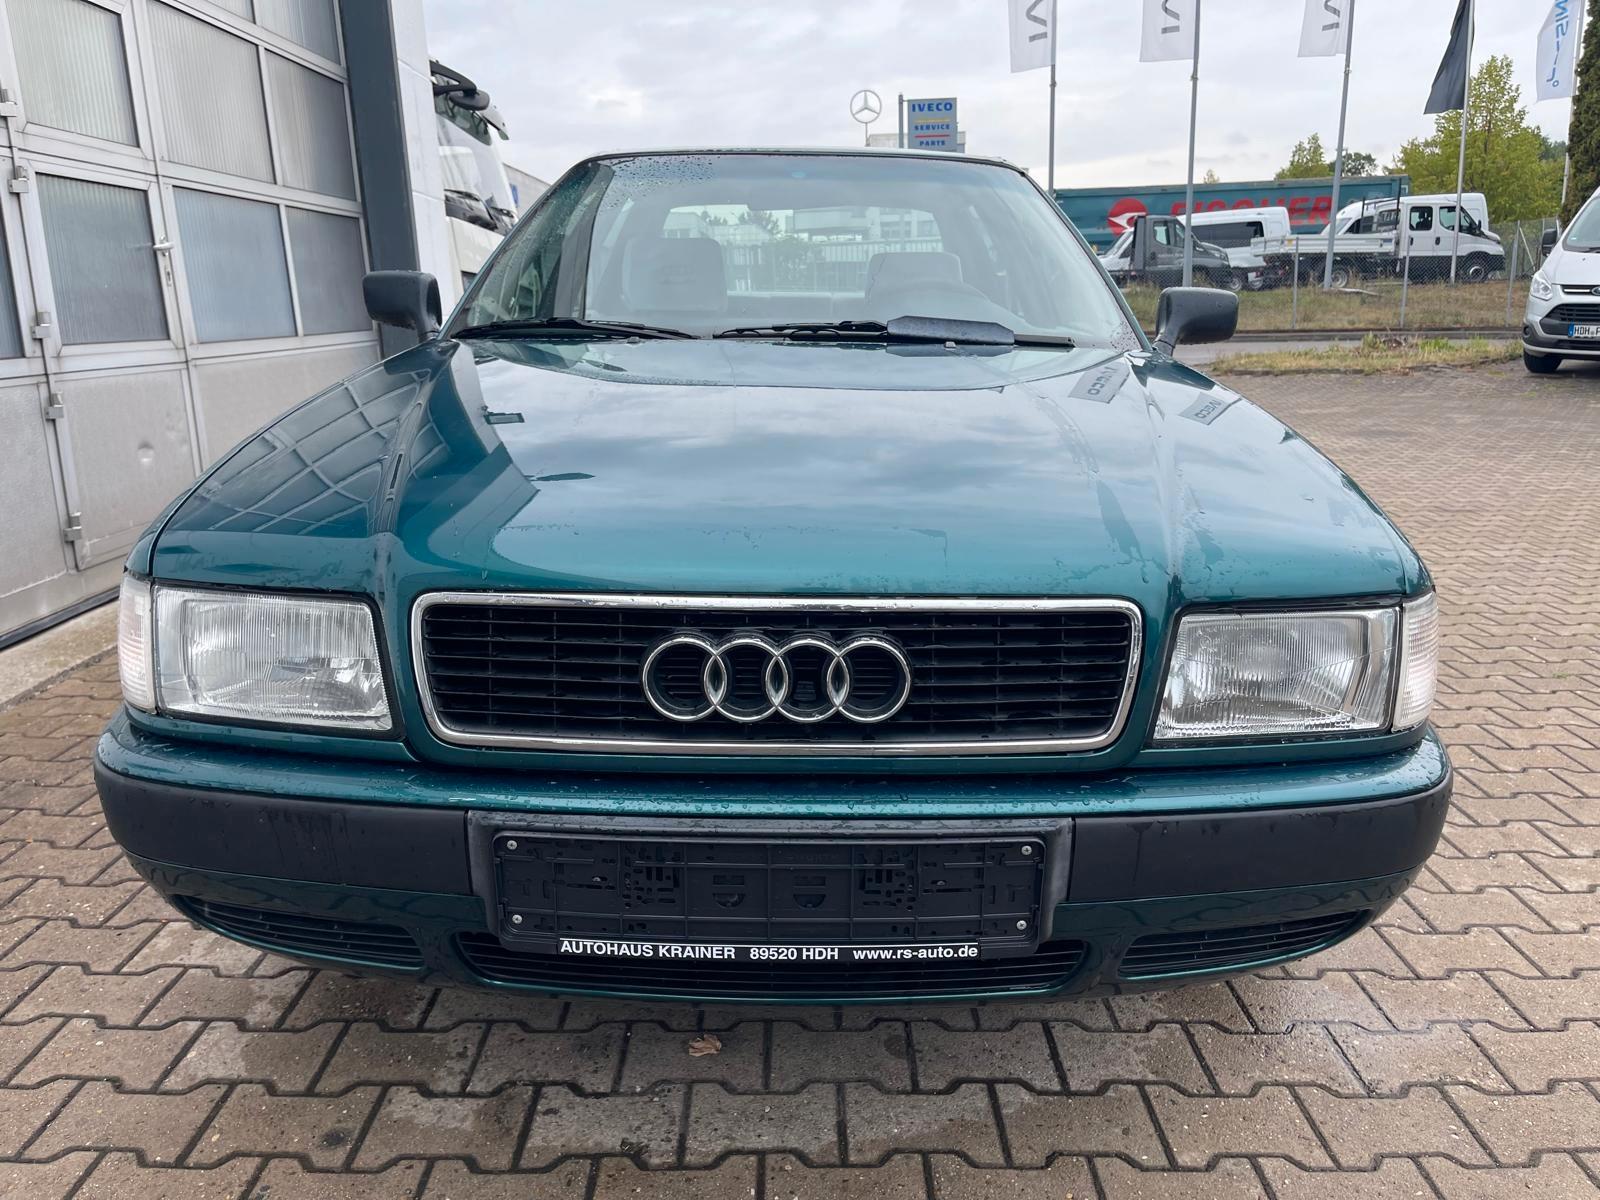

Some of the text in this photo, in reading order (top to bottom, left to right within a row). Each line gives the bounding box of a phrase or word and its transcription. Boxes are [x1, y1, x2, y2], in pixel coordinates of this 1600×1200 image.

[911, 102, 953, 113] IVECO
[1574, 326, 1590, 335] HDH
[560, 940, 978, 960] AUTOHAUS KRAINER 89520 HDH www.rs-auto.de
